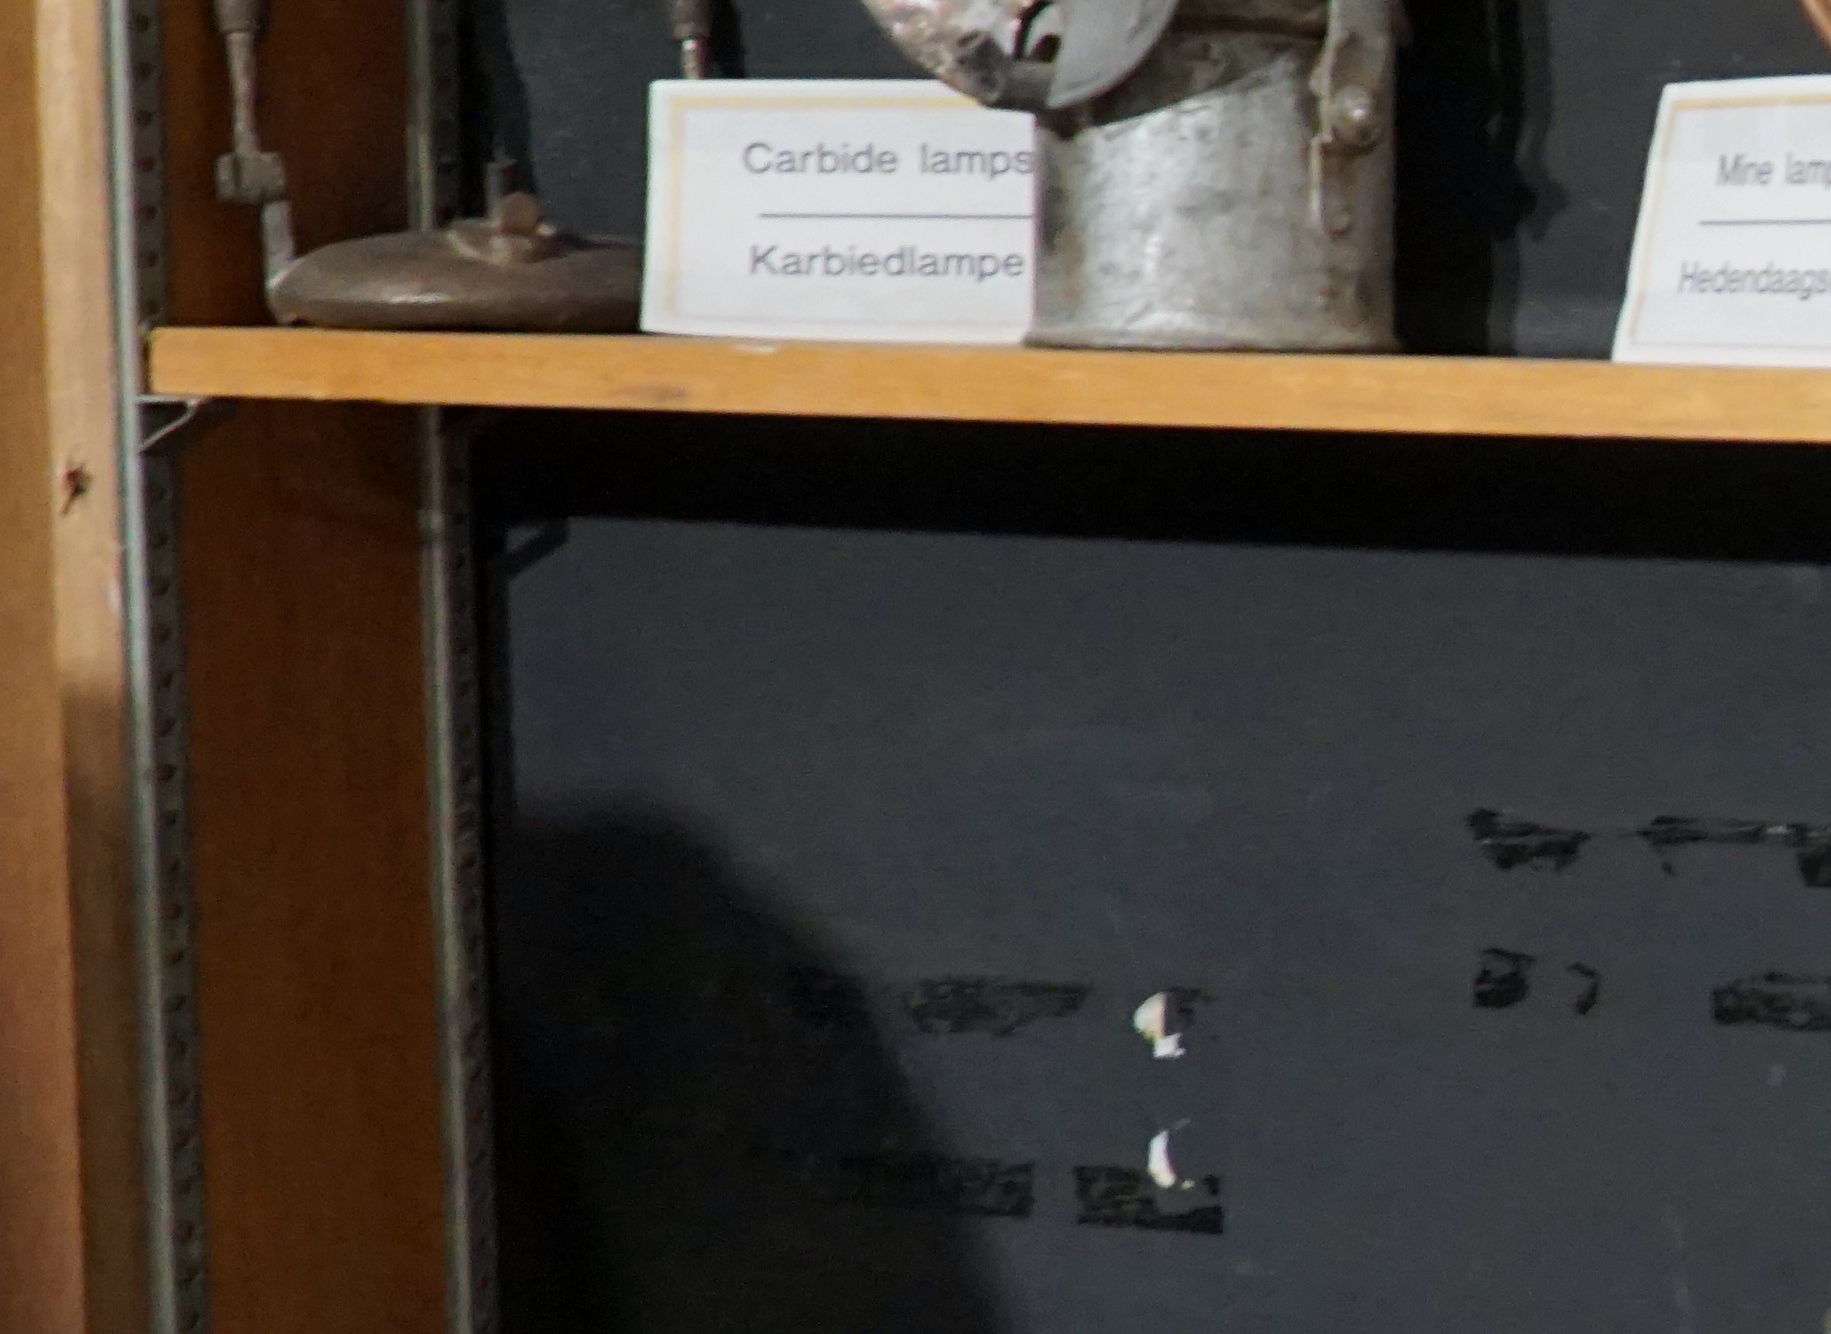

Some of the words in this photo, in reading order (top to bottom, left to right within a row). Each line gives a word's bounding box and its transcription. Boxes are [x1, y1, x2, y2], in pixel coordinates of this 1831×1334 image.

[743, 142, 897, 176] Carbide
[919, 142, 1034, 181] lamps
[1717, 152, 1772, 187] Mine
[750, 244, 1025, 285] Karbiedlampe
